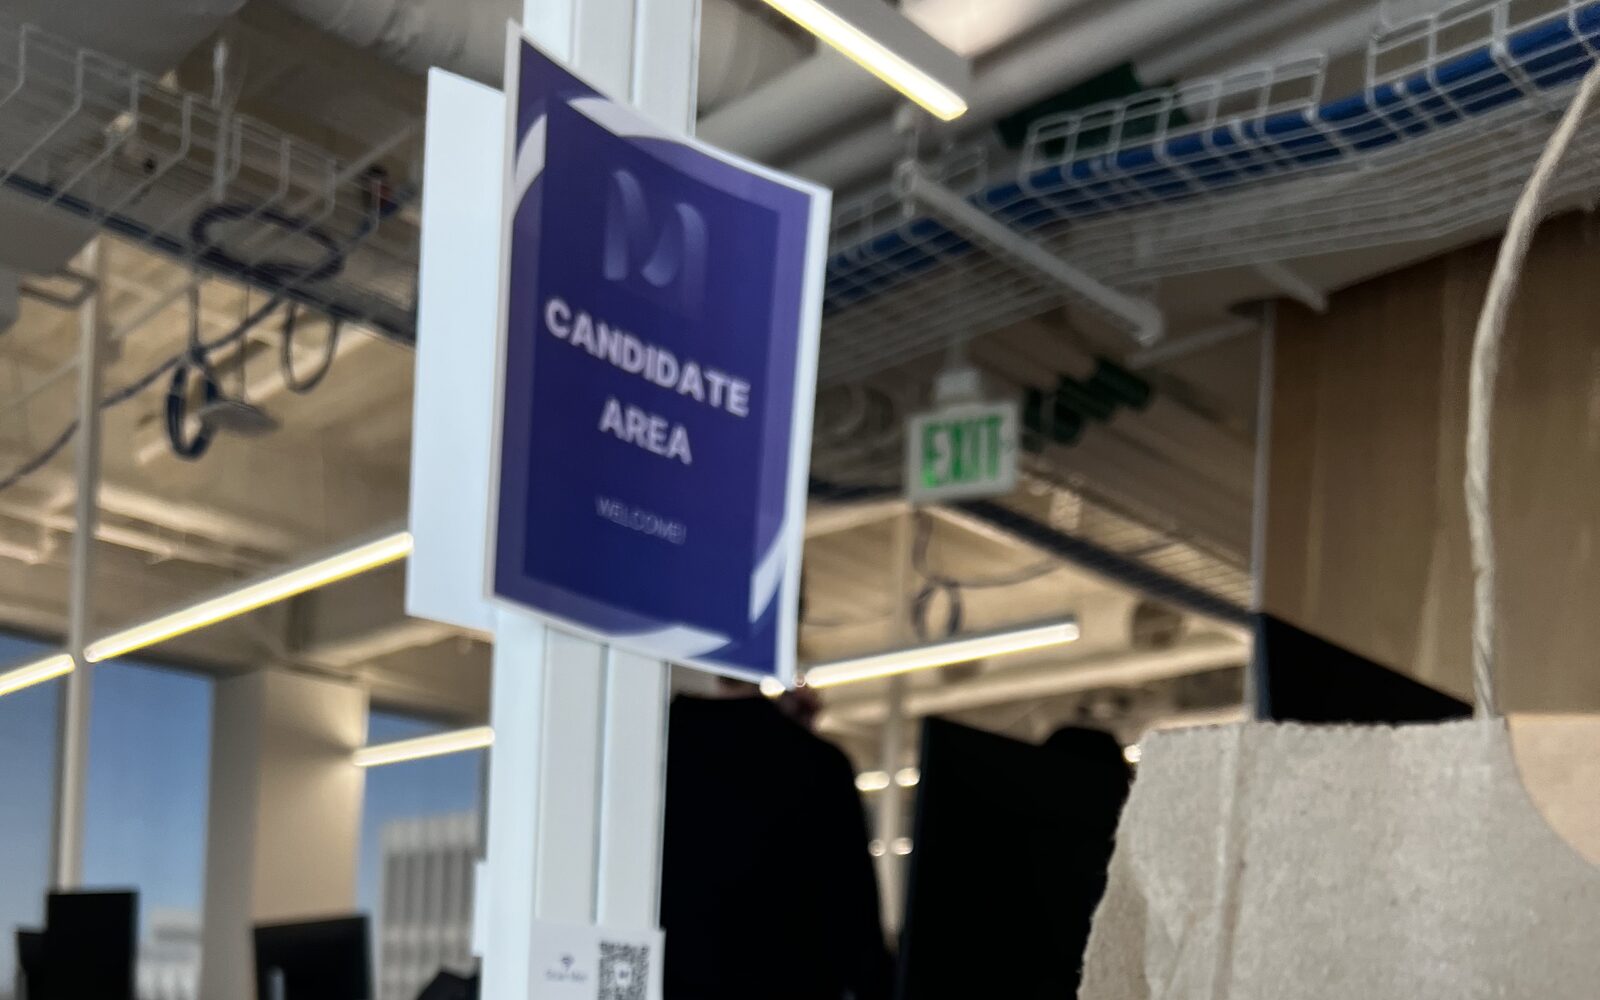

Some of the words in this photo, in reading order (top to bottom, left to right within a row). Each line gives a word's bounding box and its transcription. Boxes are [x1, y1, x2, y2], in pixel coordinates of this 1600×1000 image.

[545, 298, 751, 418] CANDIDATE
[598, 396, 692, 465] AREA
[922, 415, 1001, 488] EXIT
[595, 496, 687, 545] WELCOME!
